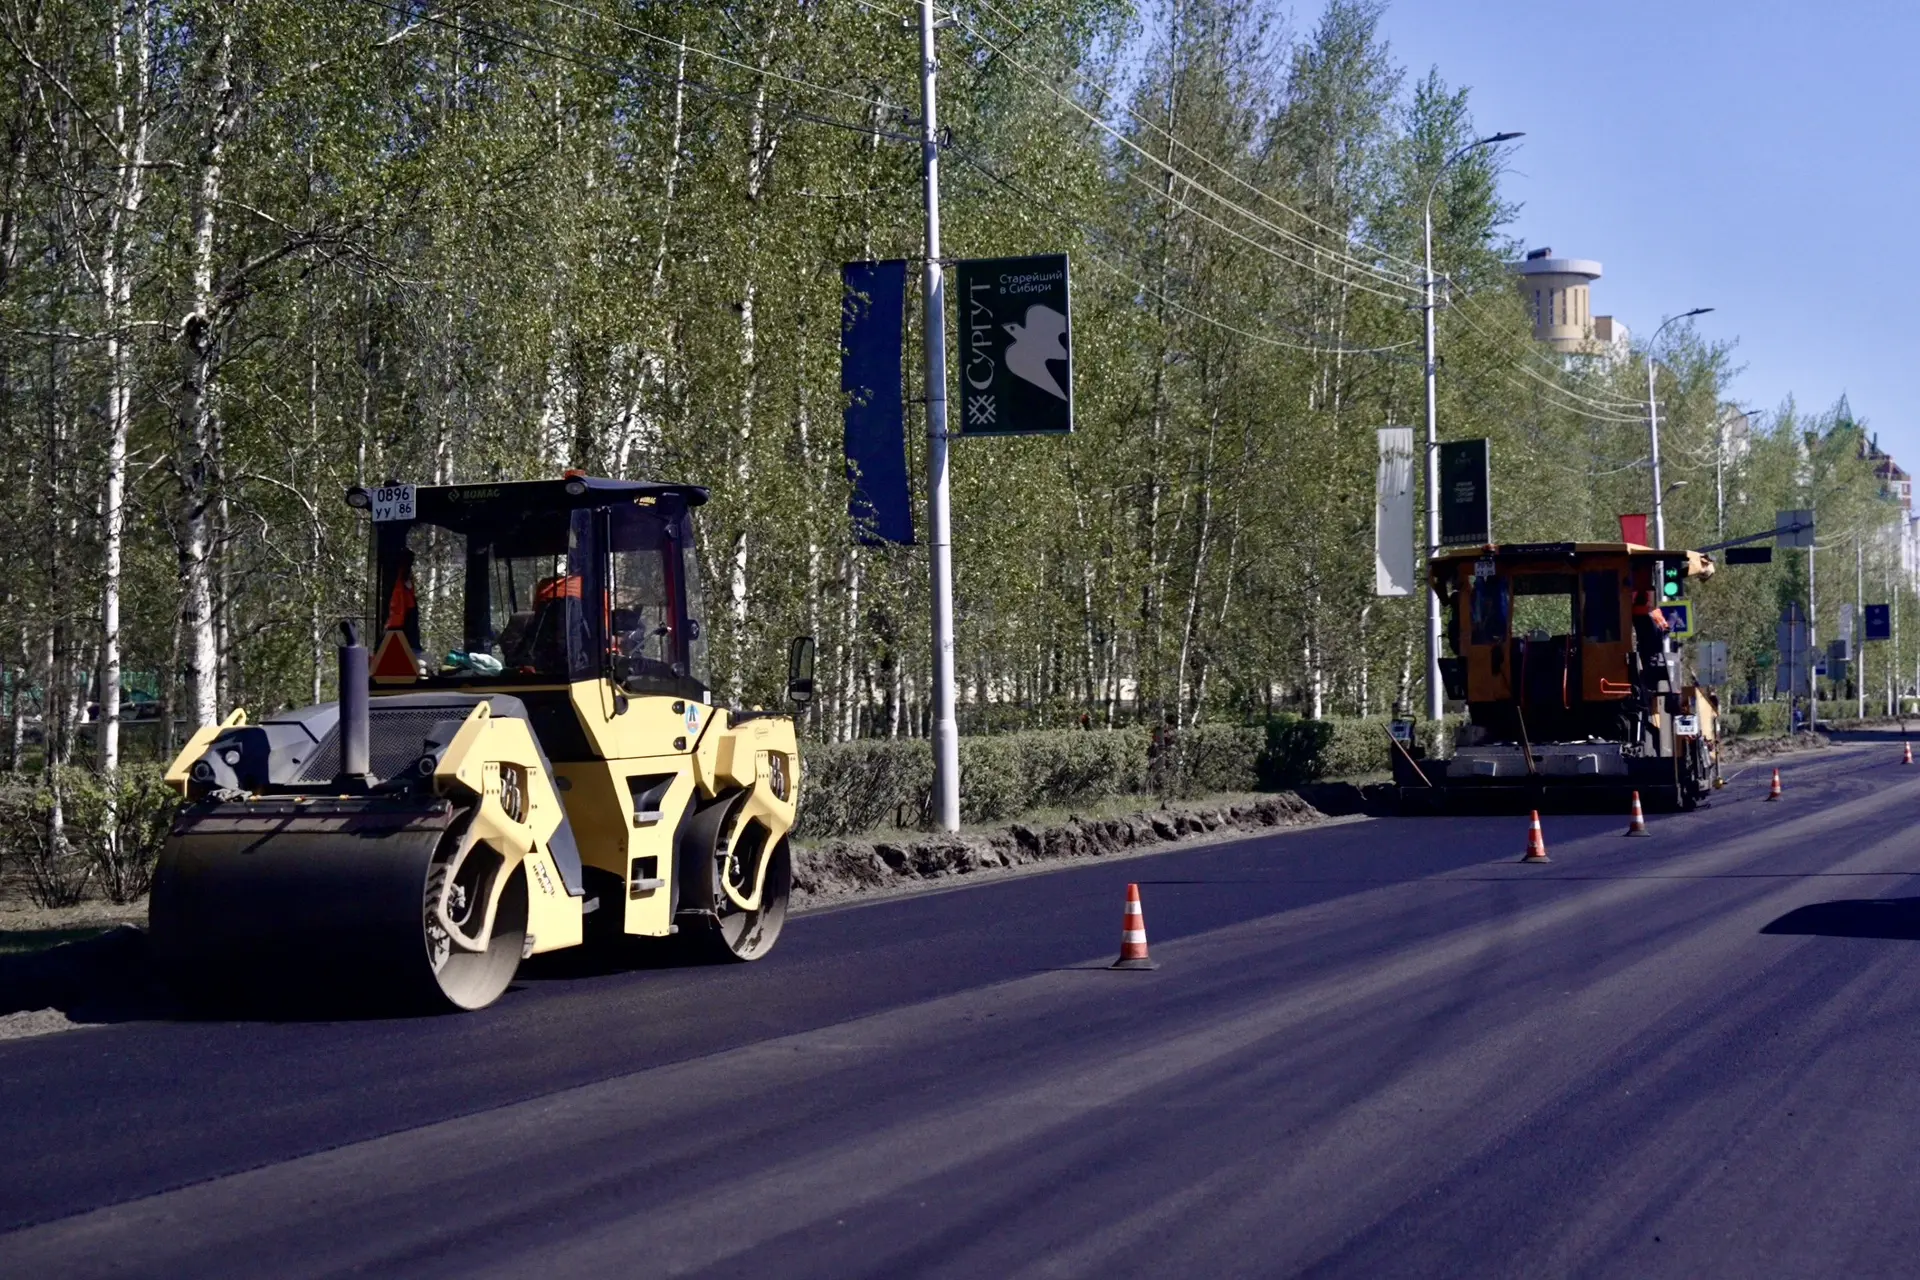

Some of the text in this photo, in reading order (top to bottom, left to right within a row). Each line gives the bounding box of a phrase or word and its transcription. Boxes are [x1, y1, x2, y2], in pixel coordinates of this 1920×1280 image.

[999, 270, 1063, 284] Старейший
[999, 283, 1051, 294] в Сибири
[377, 487, 409, 502] 0896
[399, 503, 412, 514] 86
